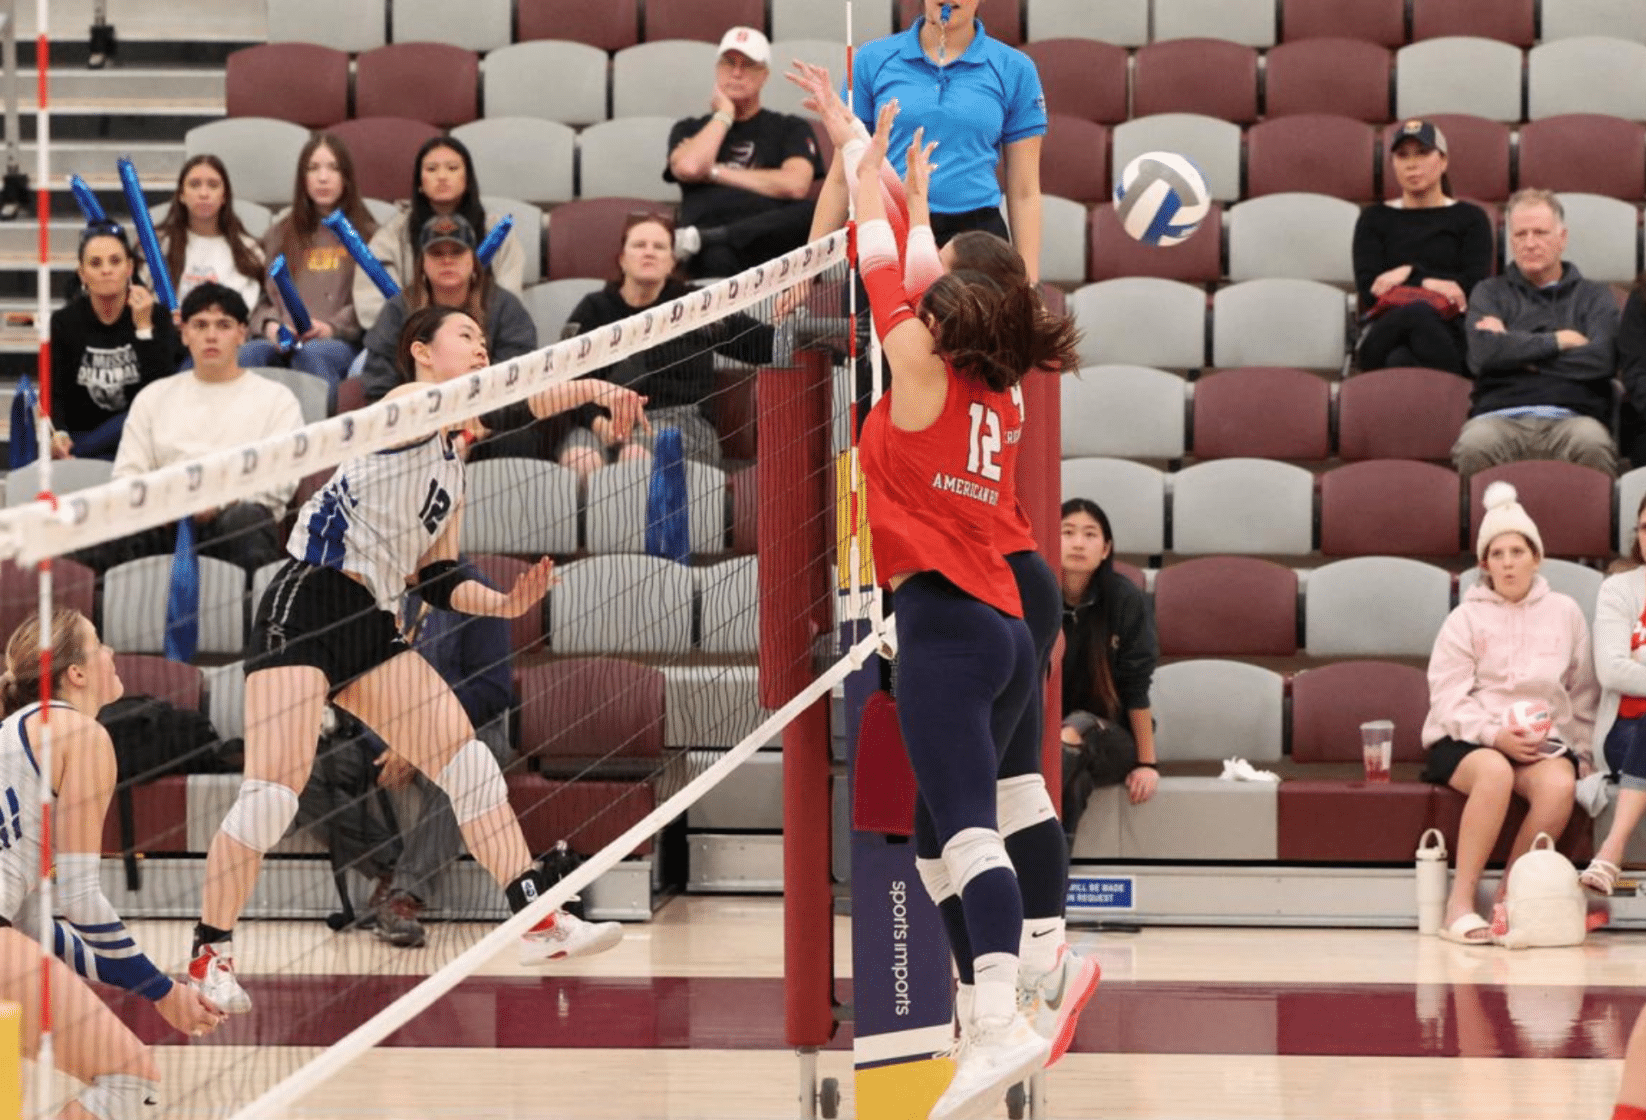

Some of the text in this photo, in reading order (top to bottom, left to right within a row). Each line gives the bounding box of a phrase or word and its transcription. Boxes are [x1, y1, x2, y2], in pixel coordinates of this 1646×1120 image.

[967, 402, 1001, 482] 12
[418, 477, 451, 535] 12
[932, 471, 989, 503] AMERICAN
[1077, 894, 1114, 902] REQUEST
[1089, 883, 1099, 892] BE
[889, 880, 911, 1016] sports imports
